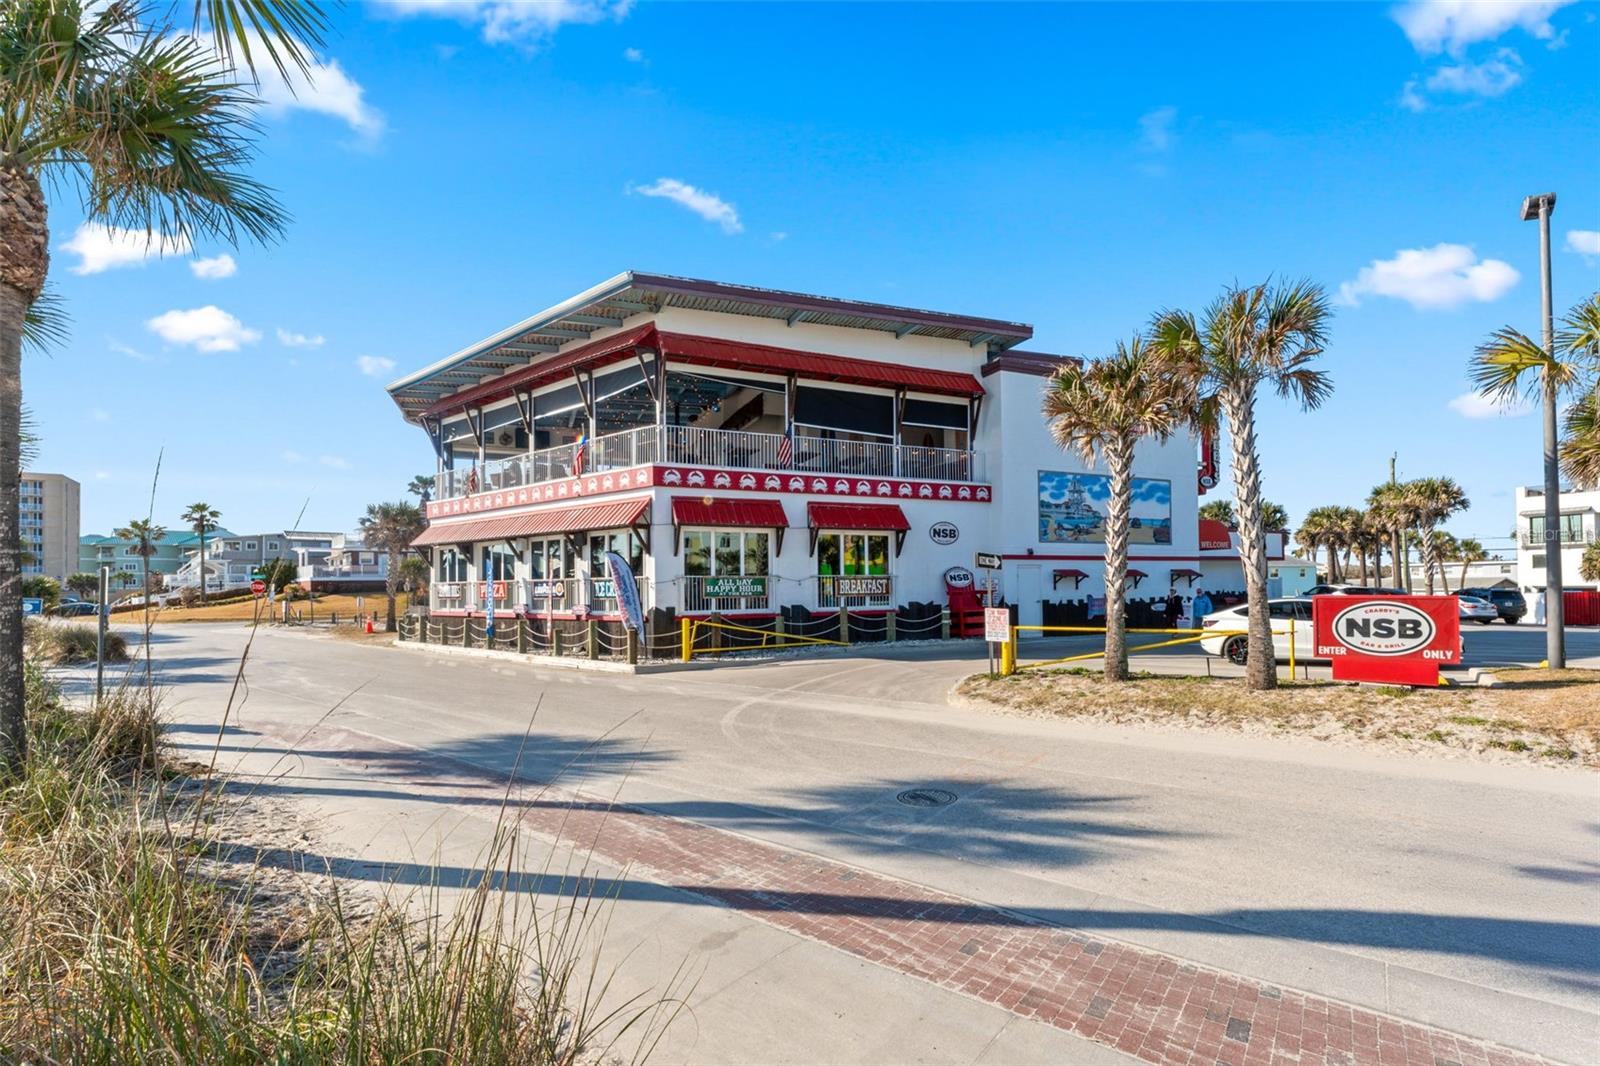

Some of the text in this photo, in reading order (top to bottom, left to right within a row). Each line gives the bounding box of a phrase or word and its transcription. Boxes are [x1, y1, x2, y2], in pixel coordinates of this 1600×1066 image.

[932, 528, 957, 539] NSB
[1200, 541, 1230, 549] WELCOME
[949, 573, 970, 582] NSB
[706, 585, 737, 593] HAPPY
[839, 579, 888, 594] BREAKFAST
[1345, 618, 1424, 640] NSB
[1318, 646, 1347, 656] ENTER
[1423, 649, 1453, 660] ONLY
